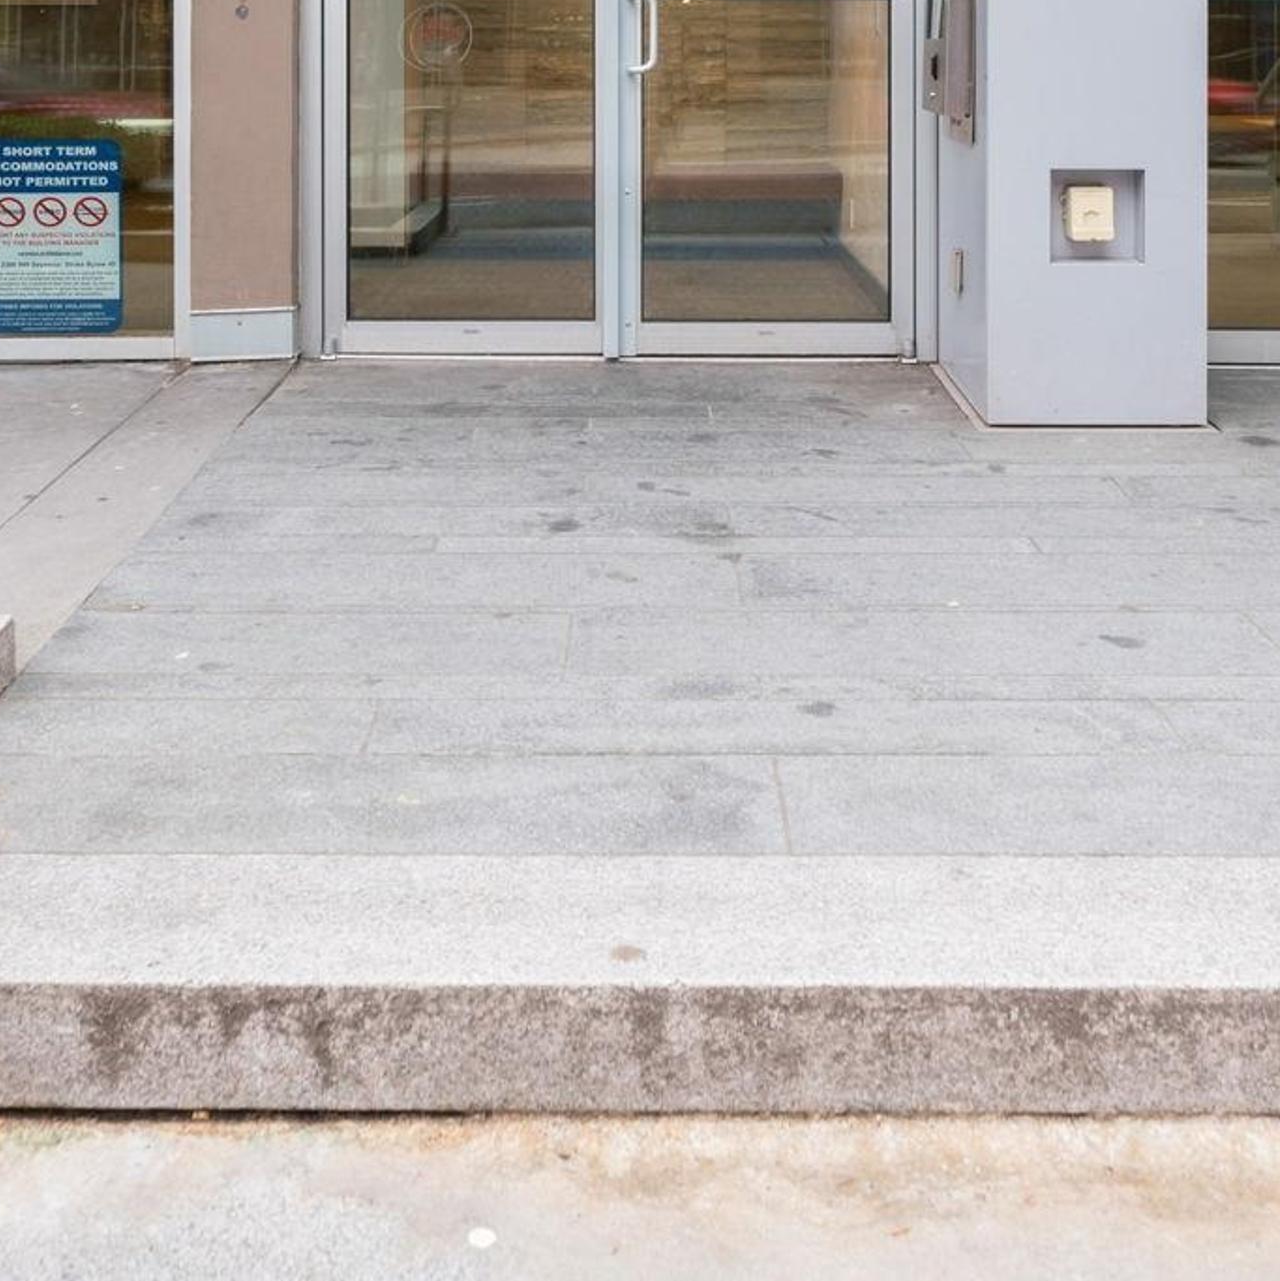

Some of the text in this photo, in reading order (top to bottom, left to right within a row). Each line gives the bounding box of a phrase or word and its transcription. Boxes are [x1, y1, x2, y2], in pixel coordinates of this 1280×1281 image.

[2, 146, 97, 156] SHORT TERM
[25, 176, 109, 187] PERMITTED
